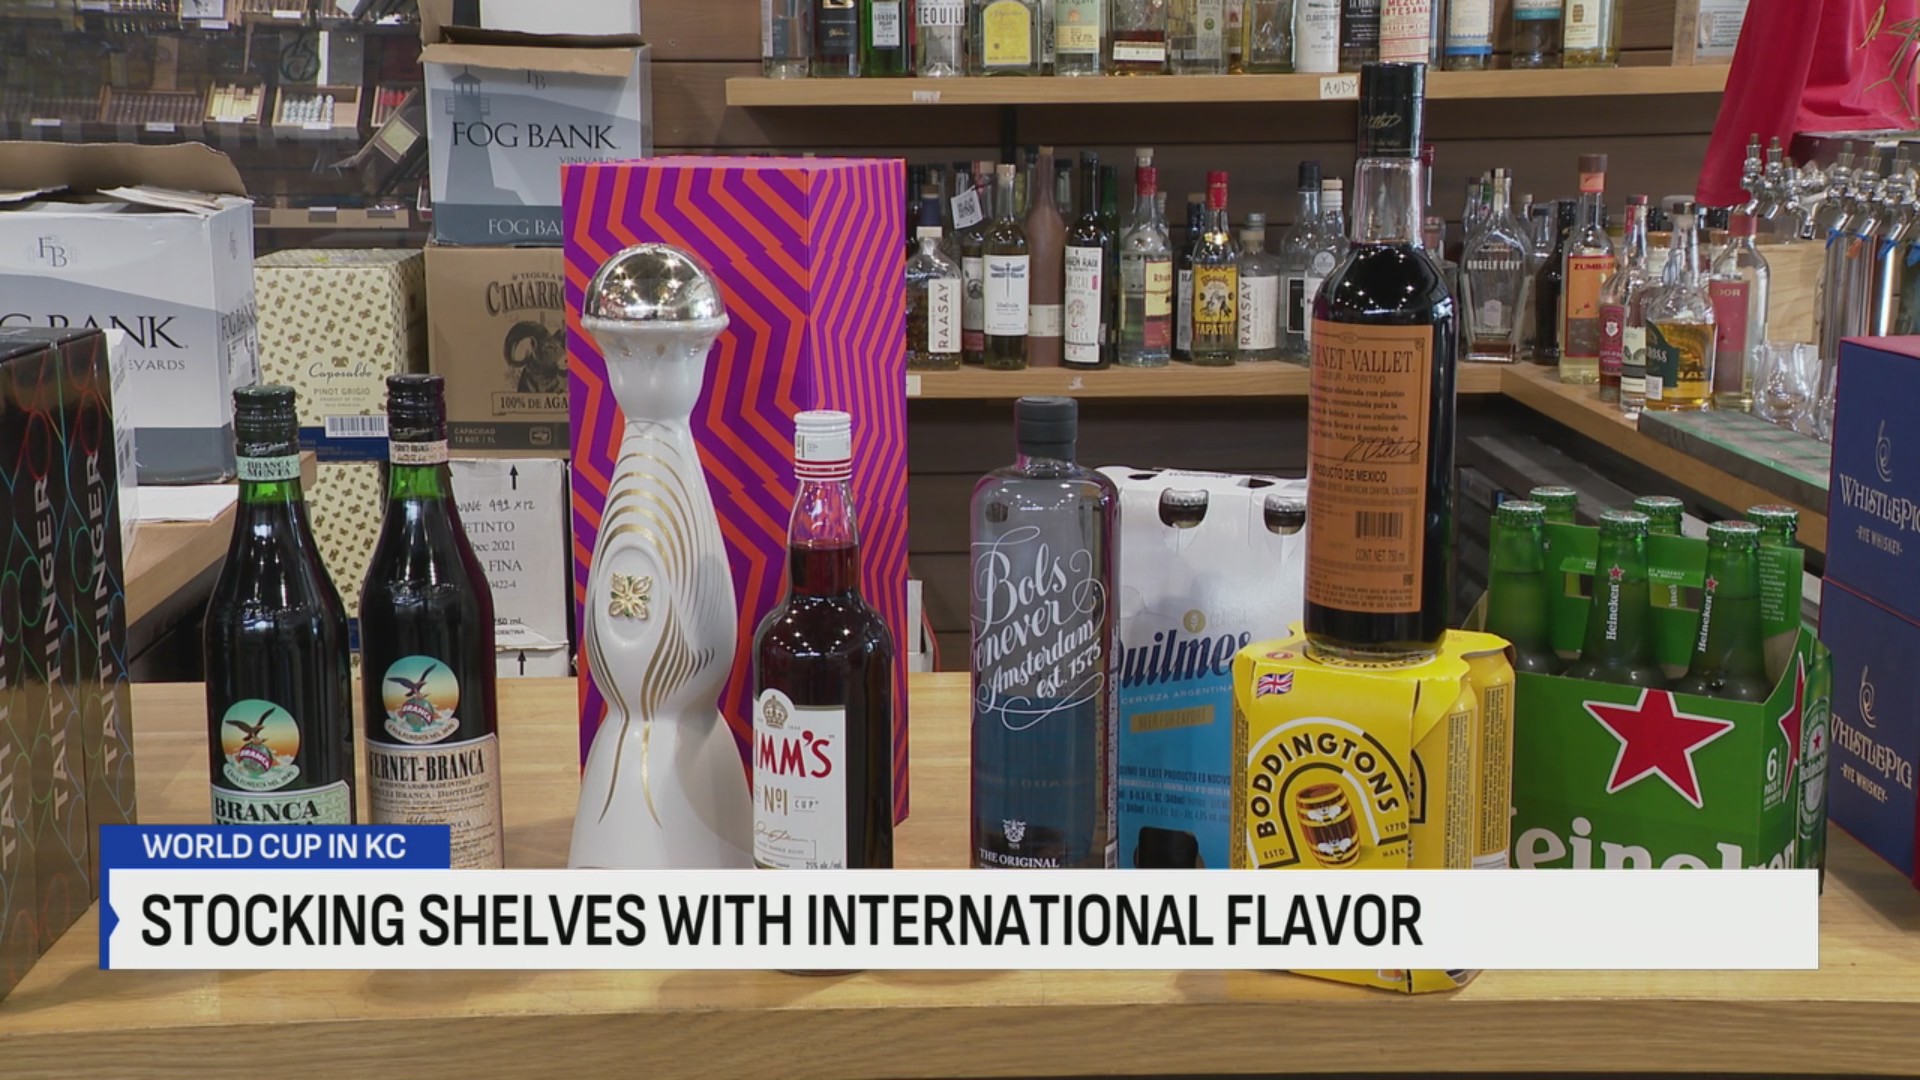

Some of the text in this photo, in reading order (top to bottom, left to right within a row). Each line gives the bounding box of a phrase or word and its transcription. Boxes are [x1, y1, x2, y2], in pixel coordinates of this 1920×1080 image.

[1324, 81, 1357, 95] ANDY
[452, 121, 518, 147] FOG
[488, 218, 530, 235] FOG
[938, 283, 949, 349] RAASAY
[1241, 281, 1252, 346] RAASAY
[1195, 323, 1234, 336] TAPATIO
[313, 387, 371, 396] PINOT GRIGIO
[500, 396, 526, 409] 100%
[528, 396, 541, 408] DE
[454, 427, 496, 435] CAPACIDAD
[1344, 470, 1354, 481] DE
[1356, 471, 1388, 483] MEXICO
[491, 540, 516, 551] 2021
[488, 560, 523, 572] FINA
[973, 543, 1068, 642] Bols
[86, 450, 118, 776] TAITTINGER
[1605, 582, 1621, 641] Heineken
[1697, 594, 1713, 653] Heineken
[34, 474, 69, 822] TAITTINGER
[1067, 639, 1103, 681] 1575
[977, 619, 1094, 713] Amsterdam
[1120, 693, 1170, 705] CERVEZA
[239, 748, 270, 771] BRANCA
[1766, 747, 1778, 782] 6
[1251, 732, 1400, 839] BODDINGTONS
[215, 797, 320, 823] BRANCA
[979, 848, 1060, 869] THE ORIGINAL
